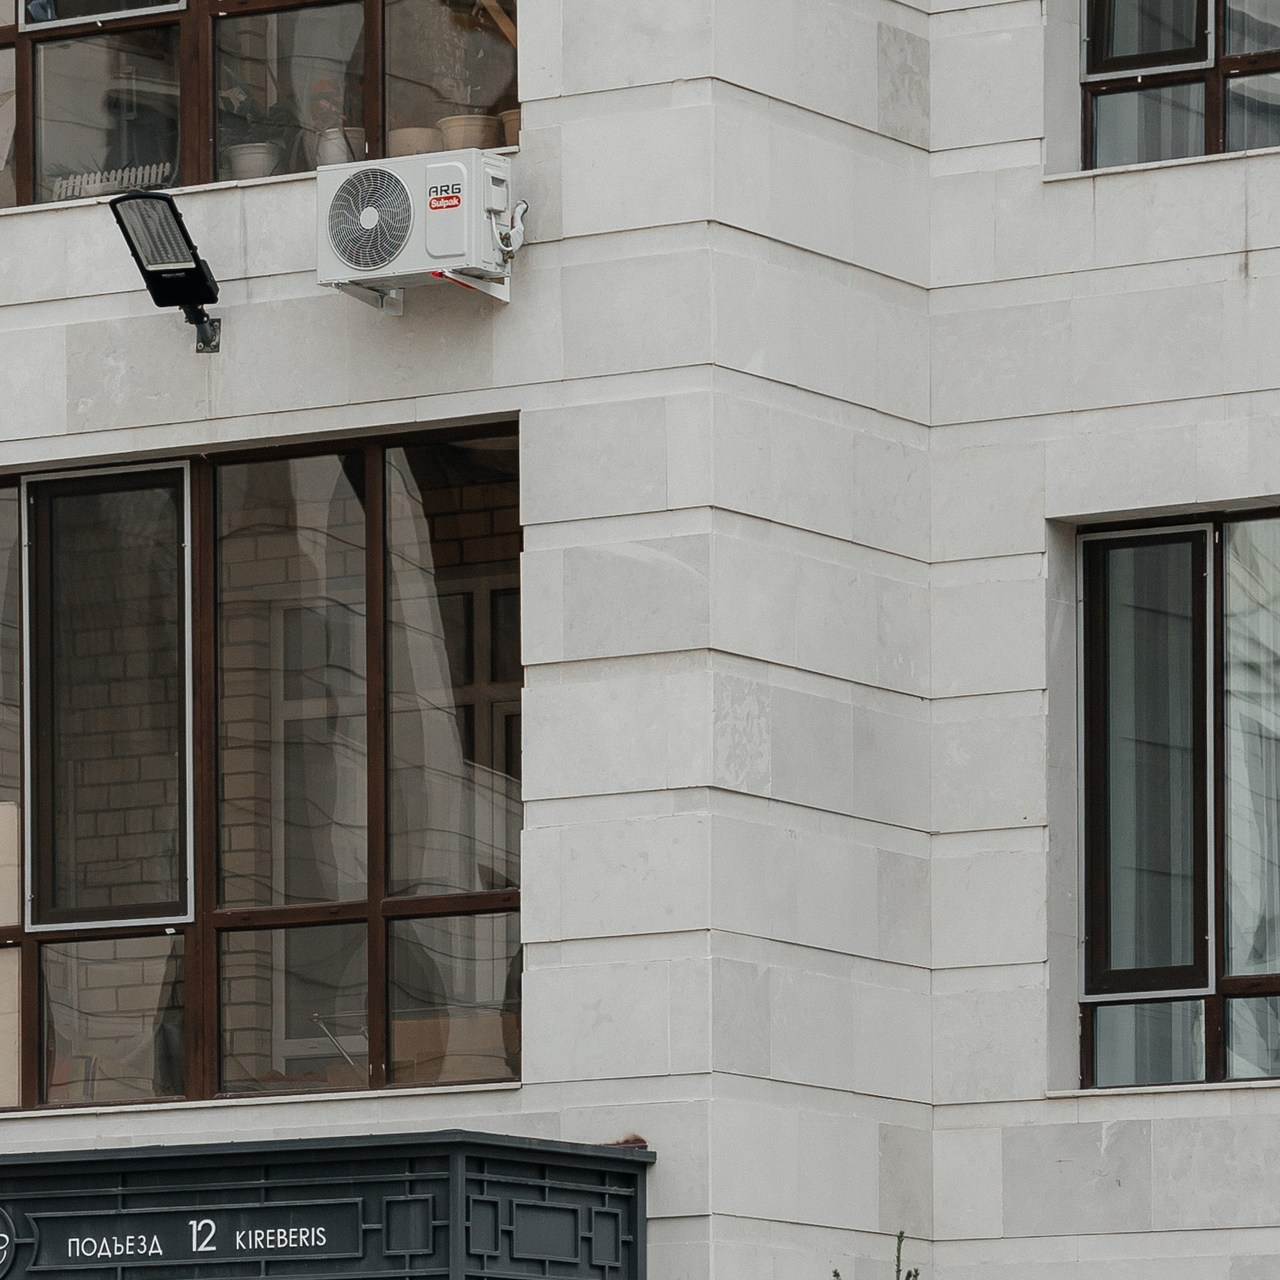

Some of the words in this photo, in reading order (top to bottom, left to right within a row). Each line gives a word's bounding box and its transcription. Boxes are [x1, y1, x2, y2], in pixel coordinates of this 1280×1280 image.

[428, 183, 462, 197] ARG
[430, 196, 460, 209] Sulpak
[68, 1234, 163, 1259] ПОДЪЕЗД
[188, 1218, 217, 1252] 12
[236, 1227, 327, 1250] KIREBERIS
